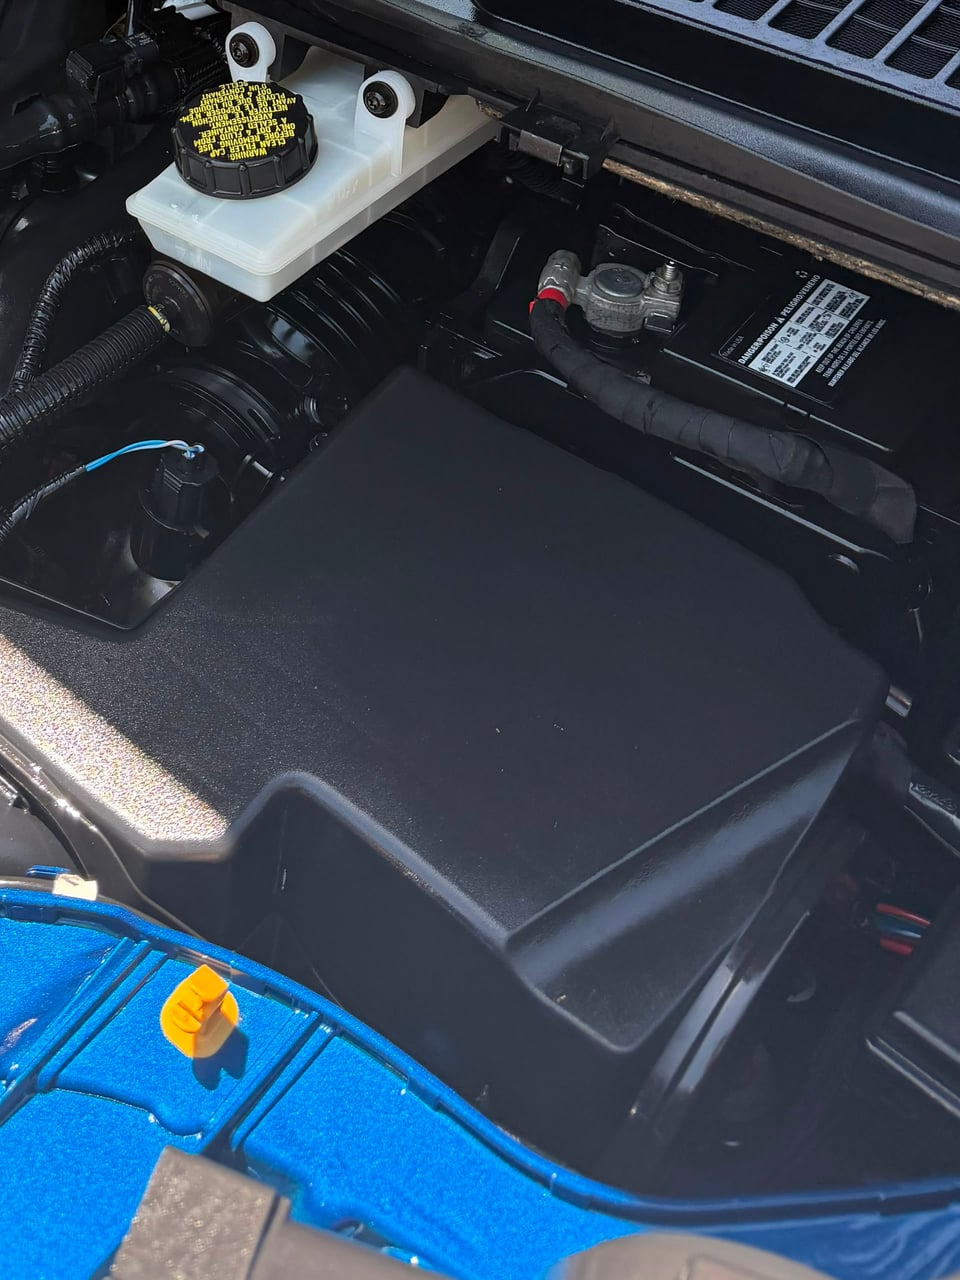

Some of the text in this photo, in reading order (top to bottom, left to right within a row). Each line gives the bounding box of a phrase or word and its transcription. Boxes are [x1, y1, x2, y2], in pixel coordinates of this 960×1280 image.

[201, 87, 244, 100] CONTENANT
[199, 93, 243, 106] PROVENANT
[236, 97, 252, 105] QUE
[272, 98, 296, 106] AVANT
[188, 103, 218, 115] LIQUIDE
[244, 103, 253, 111] LE
[192, 103, 287, 127] NETTOYER LE BOUCHON
[248, 118, 277, 129] SEALED
[274, 122, 295, 132] ONLY
[255, 126, 271, 135] DOT
[264, 129, 294, 141] BEFORE
[193, 136, 216, 146] FROM
[217, 131, 242, 141] FLUID
[198, 144, 213, 153] USE
[209, 137, 285, 157] CLEAN FILLER CAP
